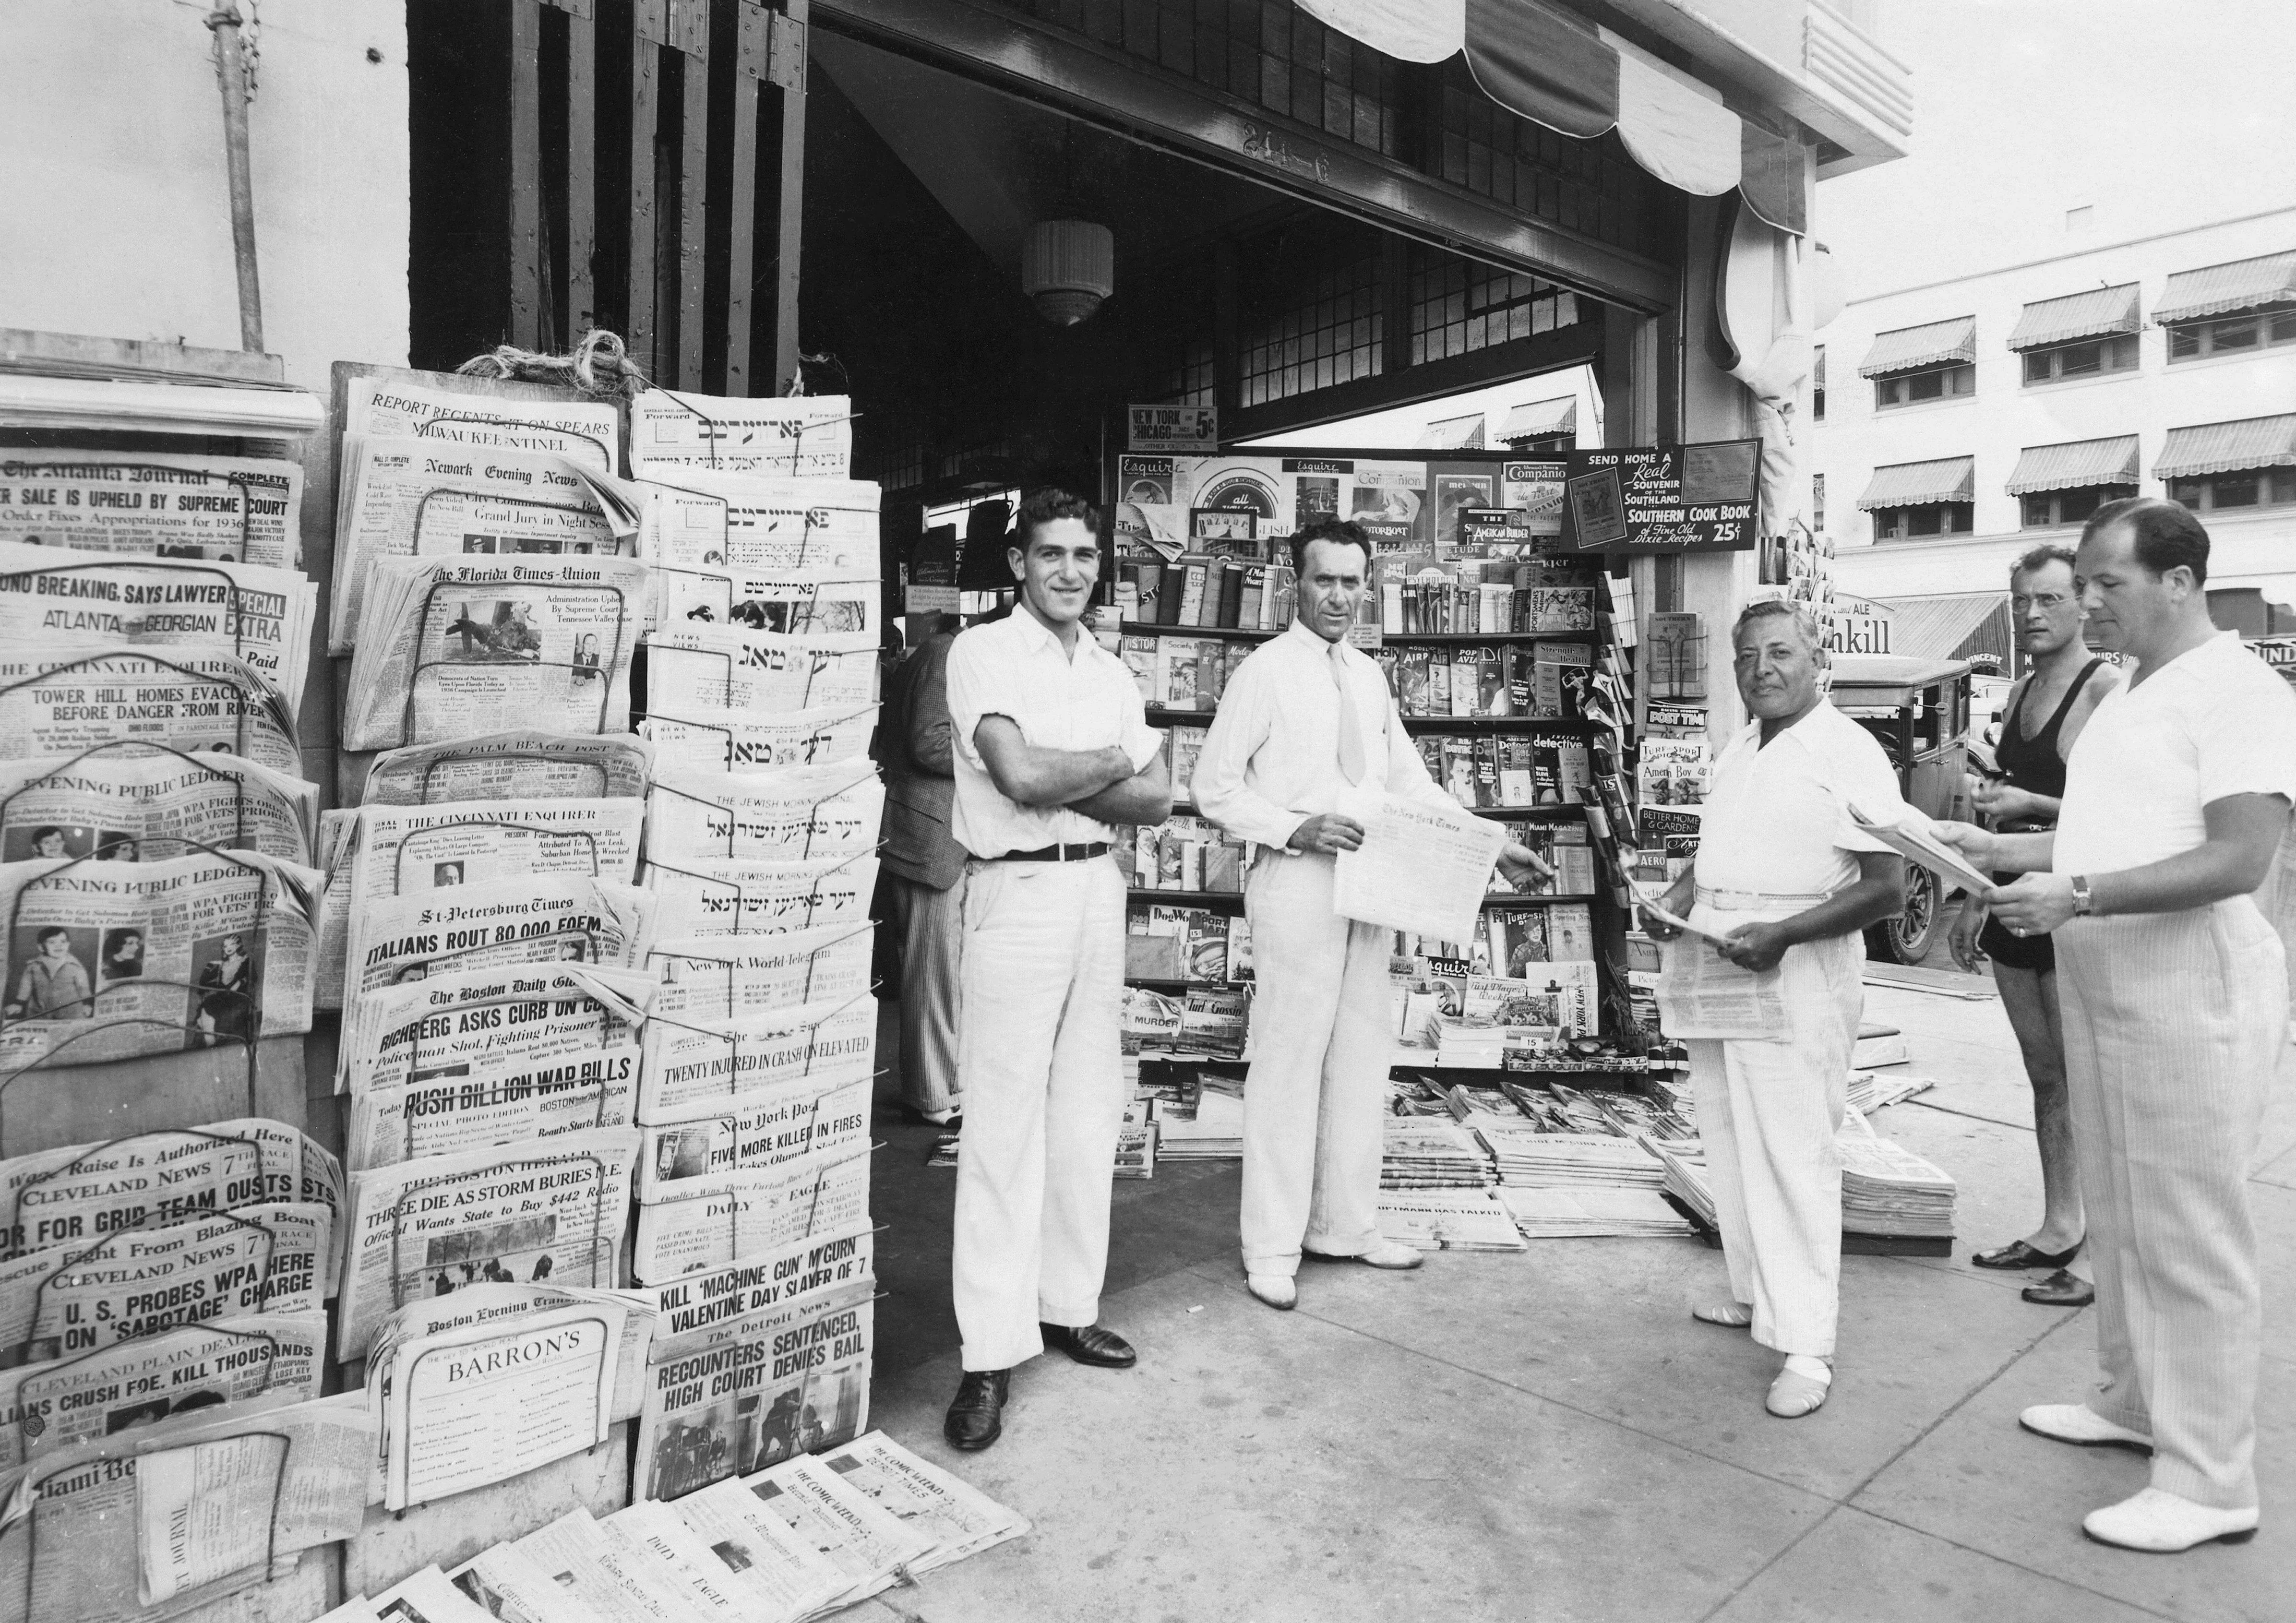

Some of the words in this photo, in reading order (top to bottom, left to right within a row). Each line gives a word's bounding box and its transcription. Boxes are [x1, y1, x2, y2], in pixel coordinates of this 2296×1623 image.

[371, 394, 430, 415] REPORT
[1133, 410, 1153, 424] NEW
[1156, 410, 1180, 425] YORK
[1133, 425, 1171, 439] CHICAGO
[1124, 458, 1185, 476] Esquire
[1297, 461, 1338, 472] Esquire
[1588, 455, 1618, 465] SEND
[1624, 454, 1656, 464] HOME
[1663, 454, 1671, 462] A
[425, 459, 473, 476] Newark
[485, 466, 532, 484] Evening
[543, 471, 578, 486] News
[1624, 463, 1670, 485] Real
[1633, 480, 1680, 490] SOUVENIR
[21, 488, 57, 505] SALE
[66, 490, 80, 506] IS
[89, 491, 142, 508] UPHELD
[150, 493, 167, 510] BY
[178, 495, 240, 513] SUPREME
[247, 498, 288, 516] COURT
[1624, 493, 1680, 506] SOUTHLAND
[193, 516, 210, 527] for
[217, 518, 244, 529] 1936
[1628, 509, 1685, 523] SOUTHERN
[1689, 506, 1717, 521] COOK
[1720, 505, 1751, 520] BOOK
[1472, 527, 1505, 542] AMERICAN
[1506, 525, 1528, 539] BUILDER
[1653, 525, 1675, 535] Fine
[1677, 523, 1696, 534] Old
[1629, 534, 1661, 544] Dixie
[1663, 534, 1702, 546] Recipes
[1447, 545, 1480, 554] ETUDE
[458, 567, 508, 581] Florida
[513, 566, 601, 581] Times-Union
[1408, 575, 1458, 584] PSYCHOLOGY
[37, 575, 121, 602] BREAKING,
[124, 584, 163, 604] SAYS
[165, 584, 226, 603] LAWYER
[546, 595, 599, 604] Administration
[565, 605, 596, 615] Supreme
[1852, 604, 1870, 615] ALE
[43, 609, 121, 633] ATLANTA
[145, 614, 216, 632] GEORGIAN
[224, 613, 281, 642] EXTRA
[557, 615, 592, 624] Tennessee
[1541, 645, 1576, 654] Strength
[247, 651, 279, 669] Paid
[1560, 655, 1588, 664] Health
[1965, 653, 2003, 666] VINCENT
[33, 688, 85, 704] TOWER
[95, 689, 127, 703] HILL
[137, 687, 184, 702] HOMES
[53, 706, 109, 721] BEFORE
[117, 705, 174, 720] DANGER
[1649, 711, 1680, 724] POST
[469, 743, 507, 754] PALM
[516, 741, 565, 753] BEACH
[1534, 734, 1583, 749] detective
[1642, 746, 1666, 755] TURF
[1673, 746, 1703, 758] SPORT
[1677, 766, 1692, 778] Boy
[119, 781, 175, 798] PUBLIC
[180, 771, 245, 789] LEDGER
[740, 797, 779, 809] JEWISH
[525, 809, 597, 820] ENQUIRER
[1643, 810, 1671, 821] BETTER
[1529, 822, 1547, 831] MIAMI
[1549, 822, 1584, 833] MAGAZINE
[1657, 821, 1699, 832] GARDENS
[1641, 855, 1666, 866] AERO
[124, 876, 188, 894] PUBLIC
[193, 865, 260, 885] LEDGER
[735, 871, 773, 881] JEWISH
[531, 897, 573, 913] Times
[1505, 912, 1527, 925] TURF
[366, 934, 439, 967] ITALIANS
[446, 927, 489, 950] ROUT
[460, 984, 506, 1000] Boston
[512, 977, 546, 994] Daily
[1188, 998, 1206, 1012] Turf
[1212, 1001, 1241, 1017] Gossip
[379, 1016, 451, 1053] RICHBERG
[459, 1008, 501, 1033] ASKS
[509, 1001, 548, 1025] CURB
[545, 1019, 597, 1036] Prisoner
[1134, 1016, 1179, 1029] MURDER
[665, 1061, 709, 1085] TWENTY
[711, 1053, 756, 1077] INJURED
[772, 1045, 803, 1068] CRASH
[819, 1036, 869, 1059] ELEVATED
[403, 1086, 453, 1119] RUSH
[460, 1077, 532, 1111] BILLION
[537, 1066, 575, 1090] WAR
[581, 1057, 631, 1081] BILLS
[540, 1097, 575, 1113] BOSTON
[741, 1137, 773, 1158] MORE
[833, 1114, 863, 1135] FIRES
[69, 1158, 119, 1175] Raise
[255, 1128, 294, 1145] Here
[157, 1161, 212, 1188] NEWS
[366, 1200, 417, 1229] THREE
[421, 1195, 449, 1212] DIE
[453, 1190, 475, 1206] AS
[478, 1179, 535, 1201] STORM
[539, 1168, 592, 1190] BURIES
[38, 1218, 84, 1243] FOR
[94, 1205, 146, 1233] GRID
[226, 1174, 293, 1203] OUSTS
[416, 1216, 455, 1231] Wants
[462, 1209, 494, 1222] State
[130, 1237, 186, 1259] From
[273, 1211, 317, 1227] Boat
[182, 1242, 236, 1269] NEWS
[126, 1280, 206, 1317] PROBES
[214, 1262, 258, 1293] WPA
[265, 1252, 316, 1276] HERE
[661, 1285, 691, 1312] KILL
[66, 1326, 97, 1351] ON
[240, 1272, 314, 1307] CHARGE
[672, 1293, 745, 1334] VALENTINE
[751, 1286, 780, 1309] DAY
[428, 1314, 473, 1335] Boston
[740, 1313, 792, 1334] Detroit
[449, 1330, 581, 1382] BARRON'S
[657, 1341, 765, 1390] RECOUNTERS
[664, 1381, 703, 1412] HIGH
[711, 1364, 766, 1397] COURT
[773, 1345, 826, 1381] DENIES
[834, 1333, 865, 1361] BAIL
[59, 1383, 119, 1412] CRUSH
[172, 1363, 209, 1386] KILL
[215, 1343, 314, 1375] THOUSANDS
[886, 1455, 917, 1479] COMIC
[807, 1481, 835, 1507] COMIC
[894, 1476, 928, 1499] TIMES
[647, 1535, 676, 1560] DAILY
[692, 1578, 728, 1609] EAGLE
